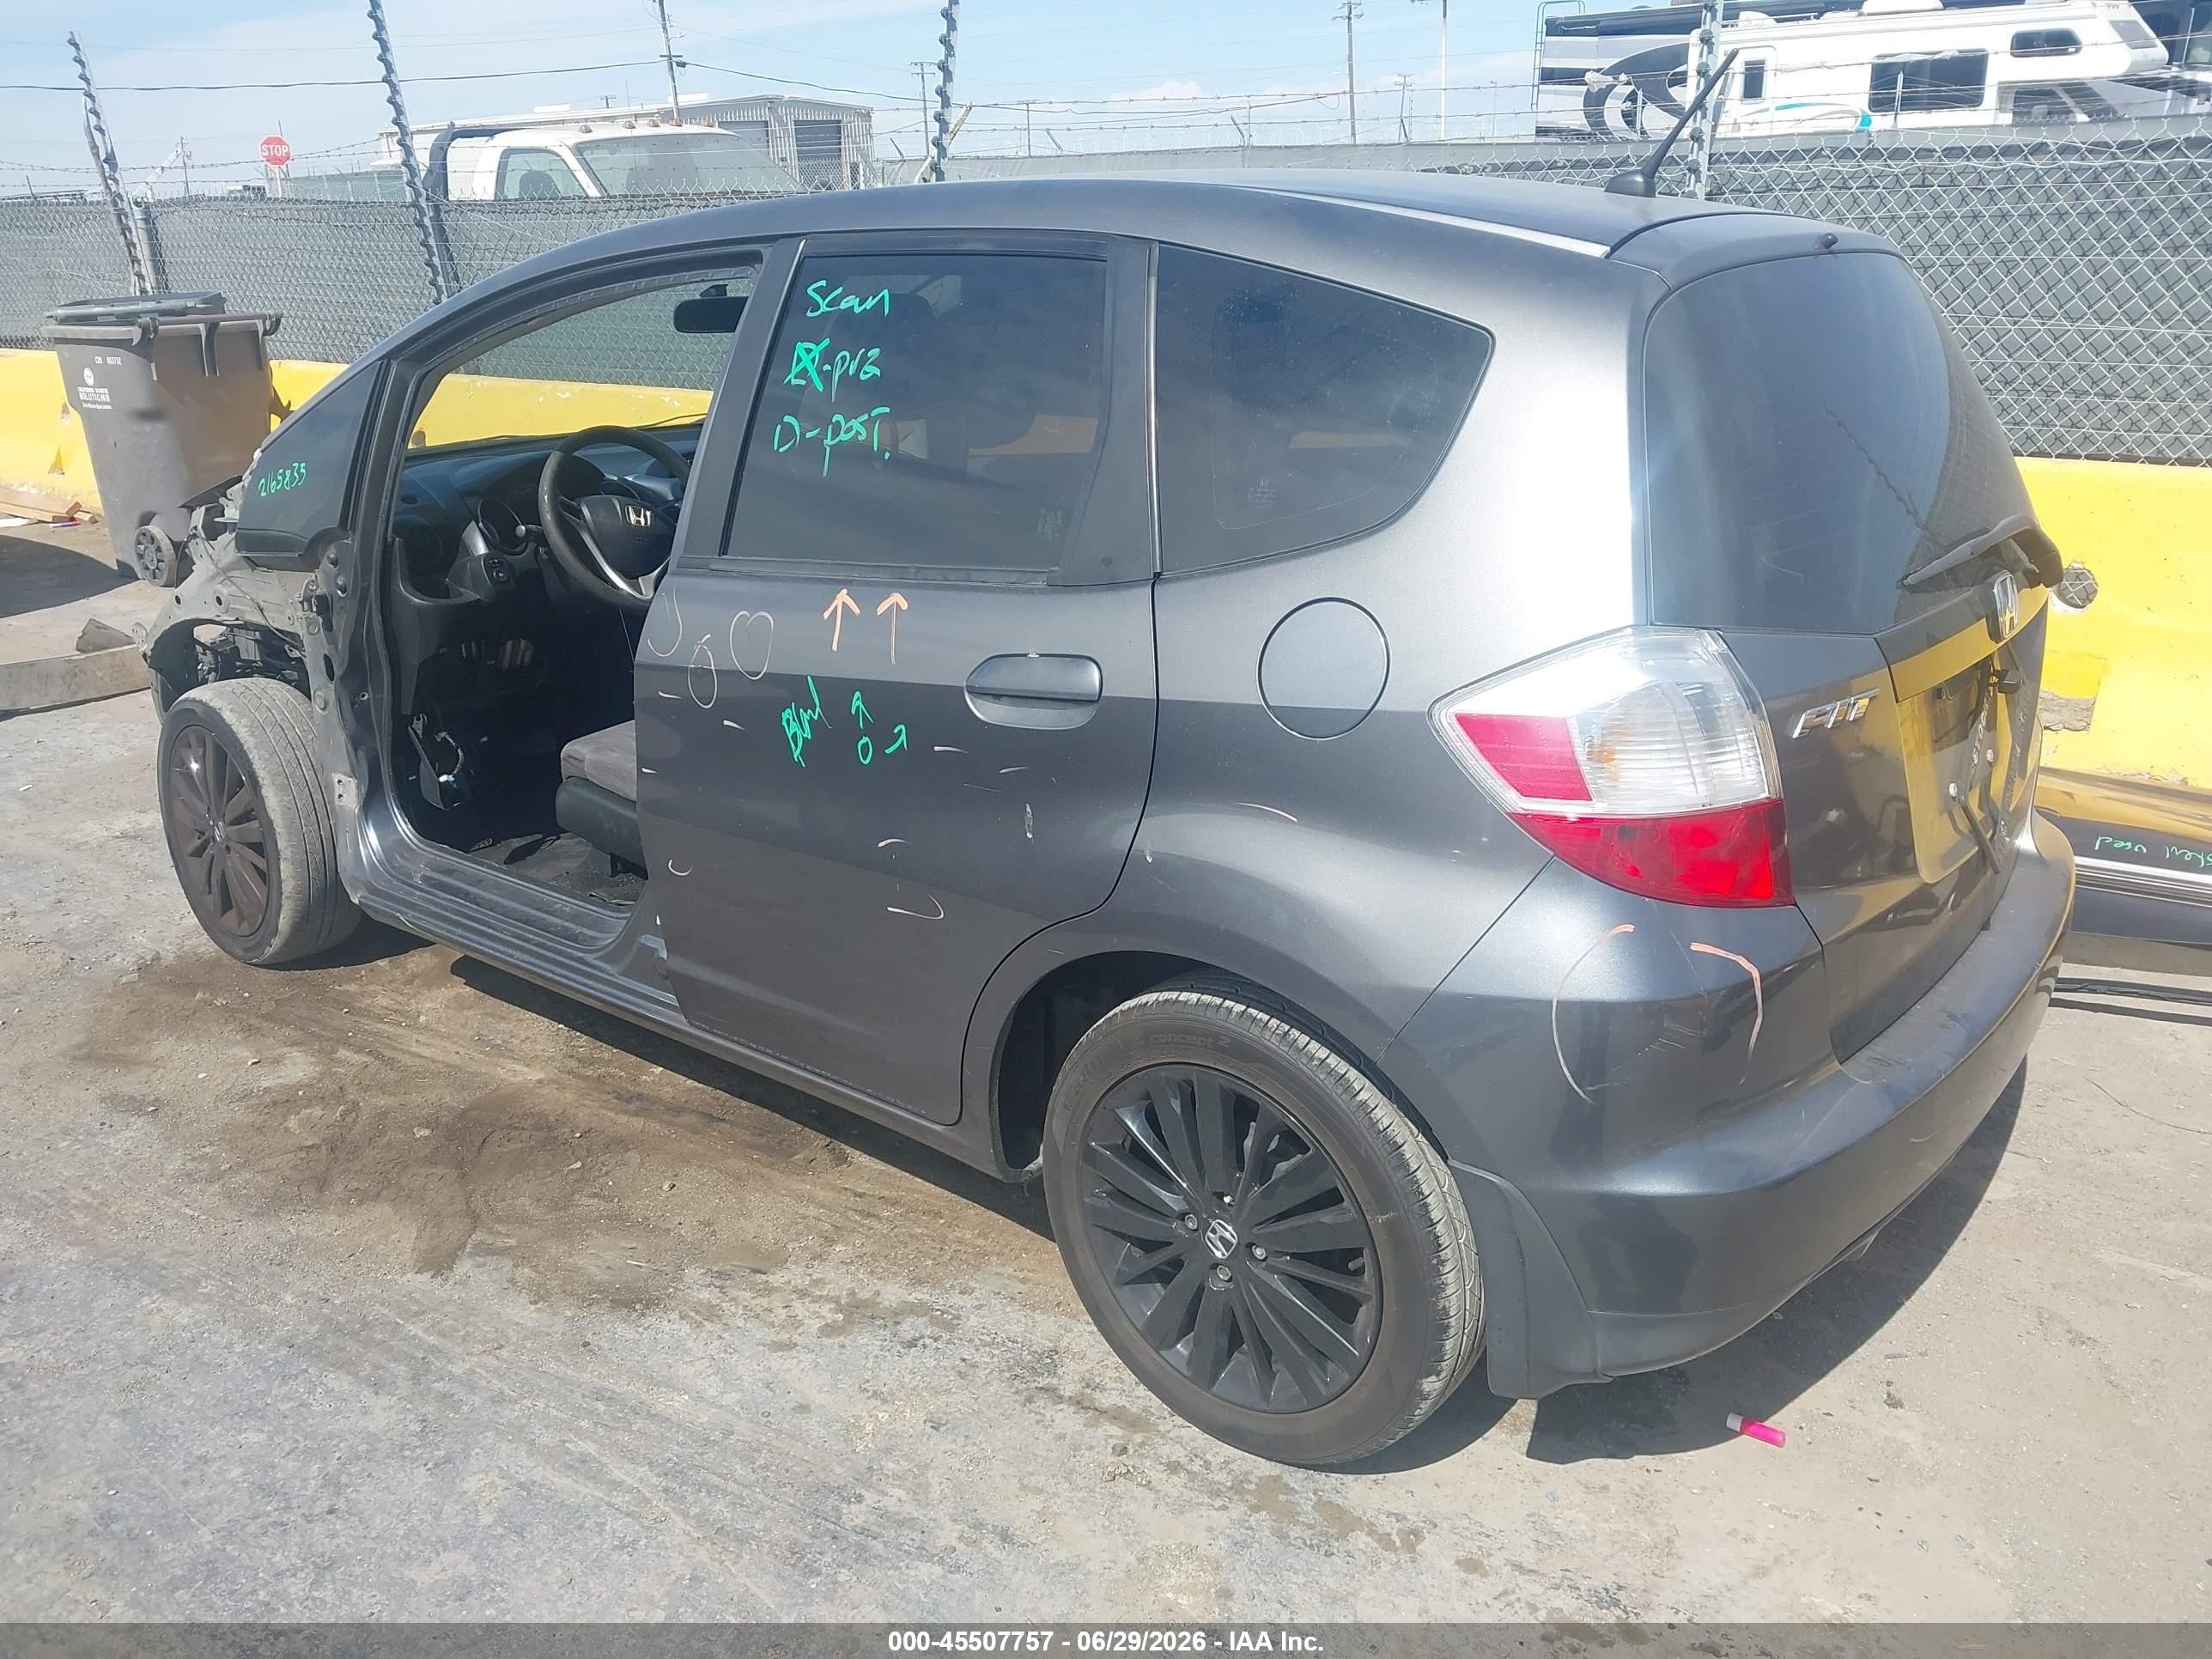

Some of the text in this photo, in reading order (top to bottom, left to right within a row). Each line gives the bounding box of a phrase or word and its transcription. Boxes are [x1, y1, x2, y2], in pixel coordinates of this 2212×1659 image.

[262, 144, 289, 156] STOP
[805, 279, 890, 318] Scan
[258, 462, 307, 497] 2165835
[1789, 687, 1881, 739] FIT
[2094, 836, 2148, 854] used
[1152, 1033, 1215, 1048] concept
